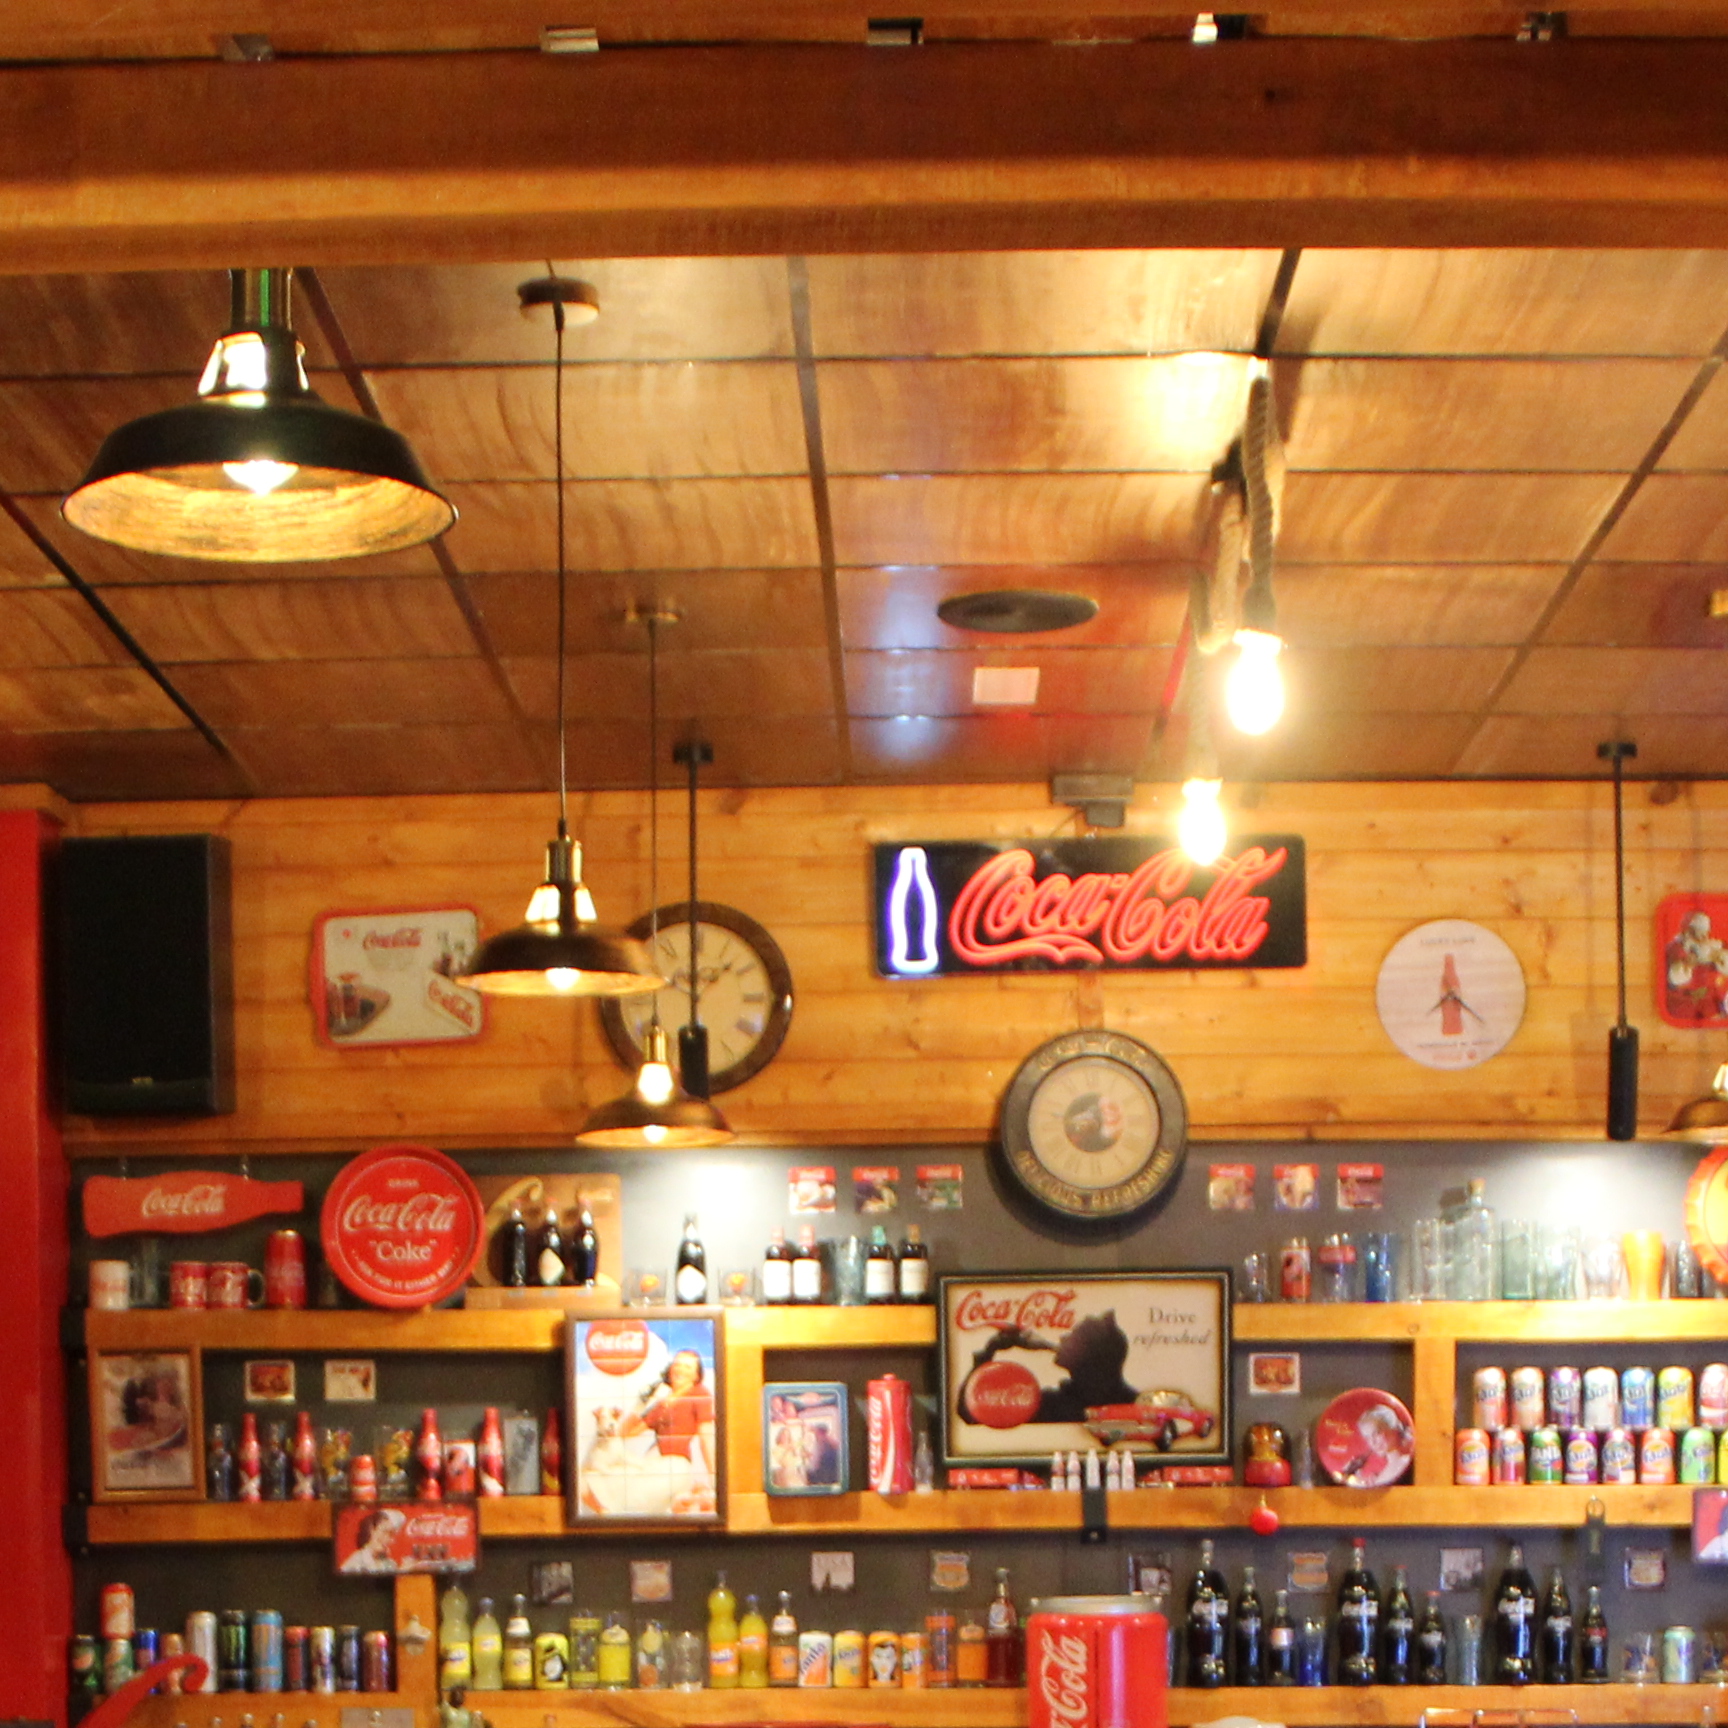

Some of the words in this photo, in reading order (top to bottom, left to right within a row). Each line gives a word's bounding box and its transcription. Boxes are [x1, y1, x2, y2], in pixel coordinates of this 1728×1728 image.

[948, 846, 1287, 965] Coca-Cola
[141, 1184, 227, 1219] Coca-Cola
[343, 1192, 459, 1233] Coca-Cola
[955, 1287, 1079, 1332] Coca-Cola
[1148, 1305, 1197, 1326] Drive
[1133, 1326, 1214, 1348] refreshed
